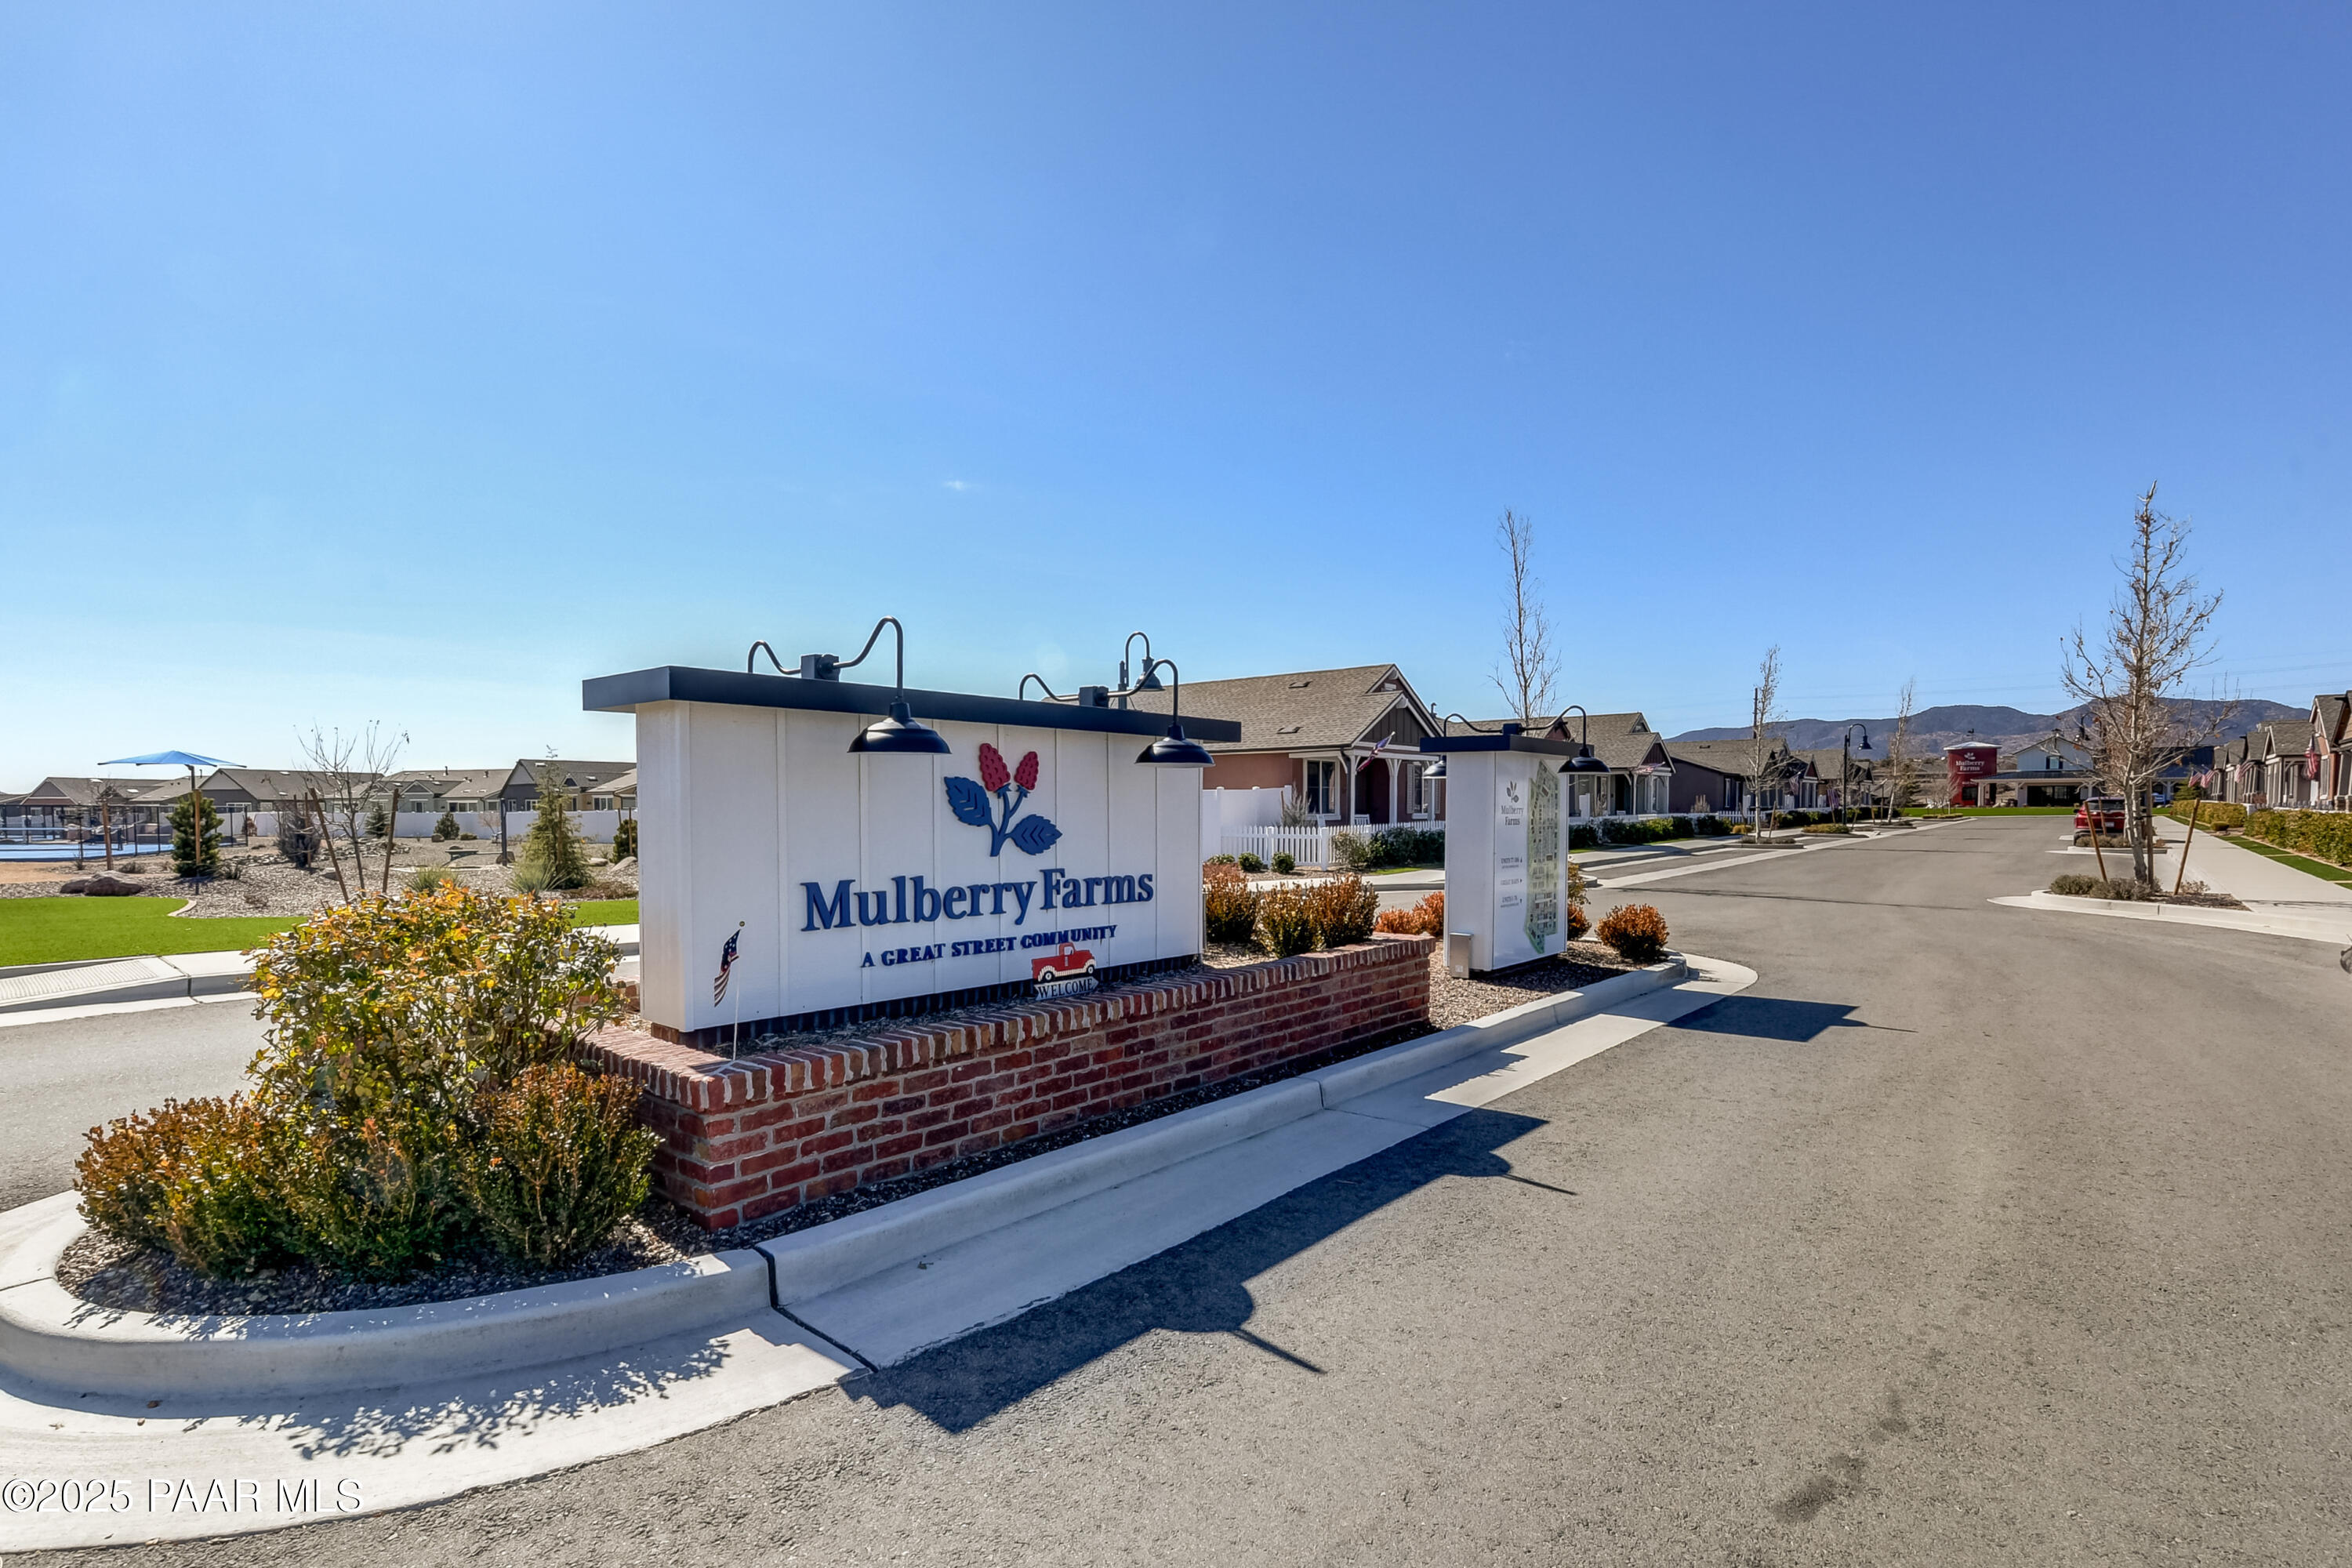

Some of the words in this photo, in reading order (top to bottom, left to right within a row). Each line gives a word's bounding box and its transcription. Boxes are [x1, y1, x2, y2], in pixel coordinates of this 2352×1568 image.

[1501, 805, 1524, 815] Mulberry
[1504, 816, 1520, 826] Farms
[800, 875, 1036, 931] Mulberry
[1040, 867, 1155, 910] Farms
[860, 951, 875, 968] A
[880, 943, 946, 967] GREAT
[951, 936, 1017, 957] STREET
[1021, 924, 1118, 949] COMMUNITY
[1037, 978, 1093, 999] WELCOME
